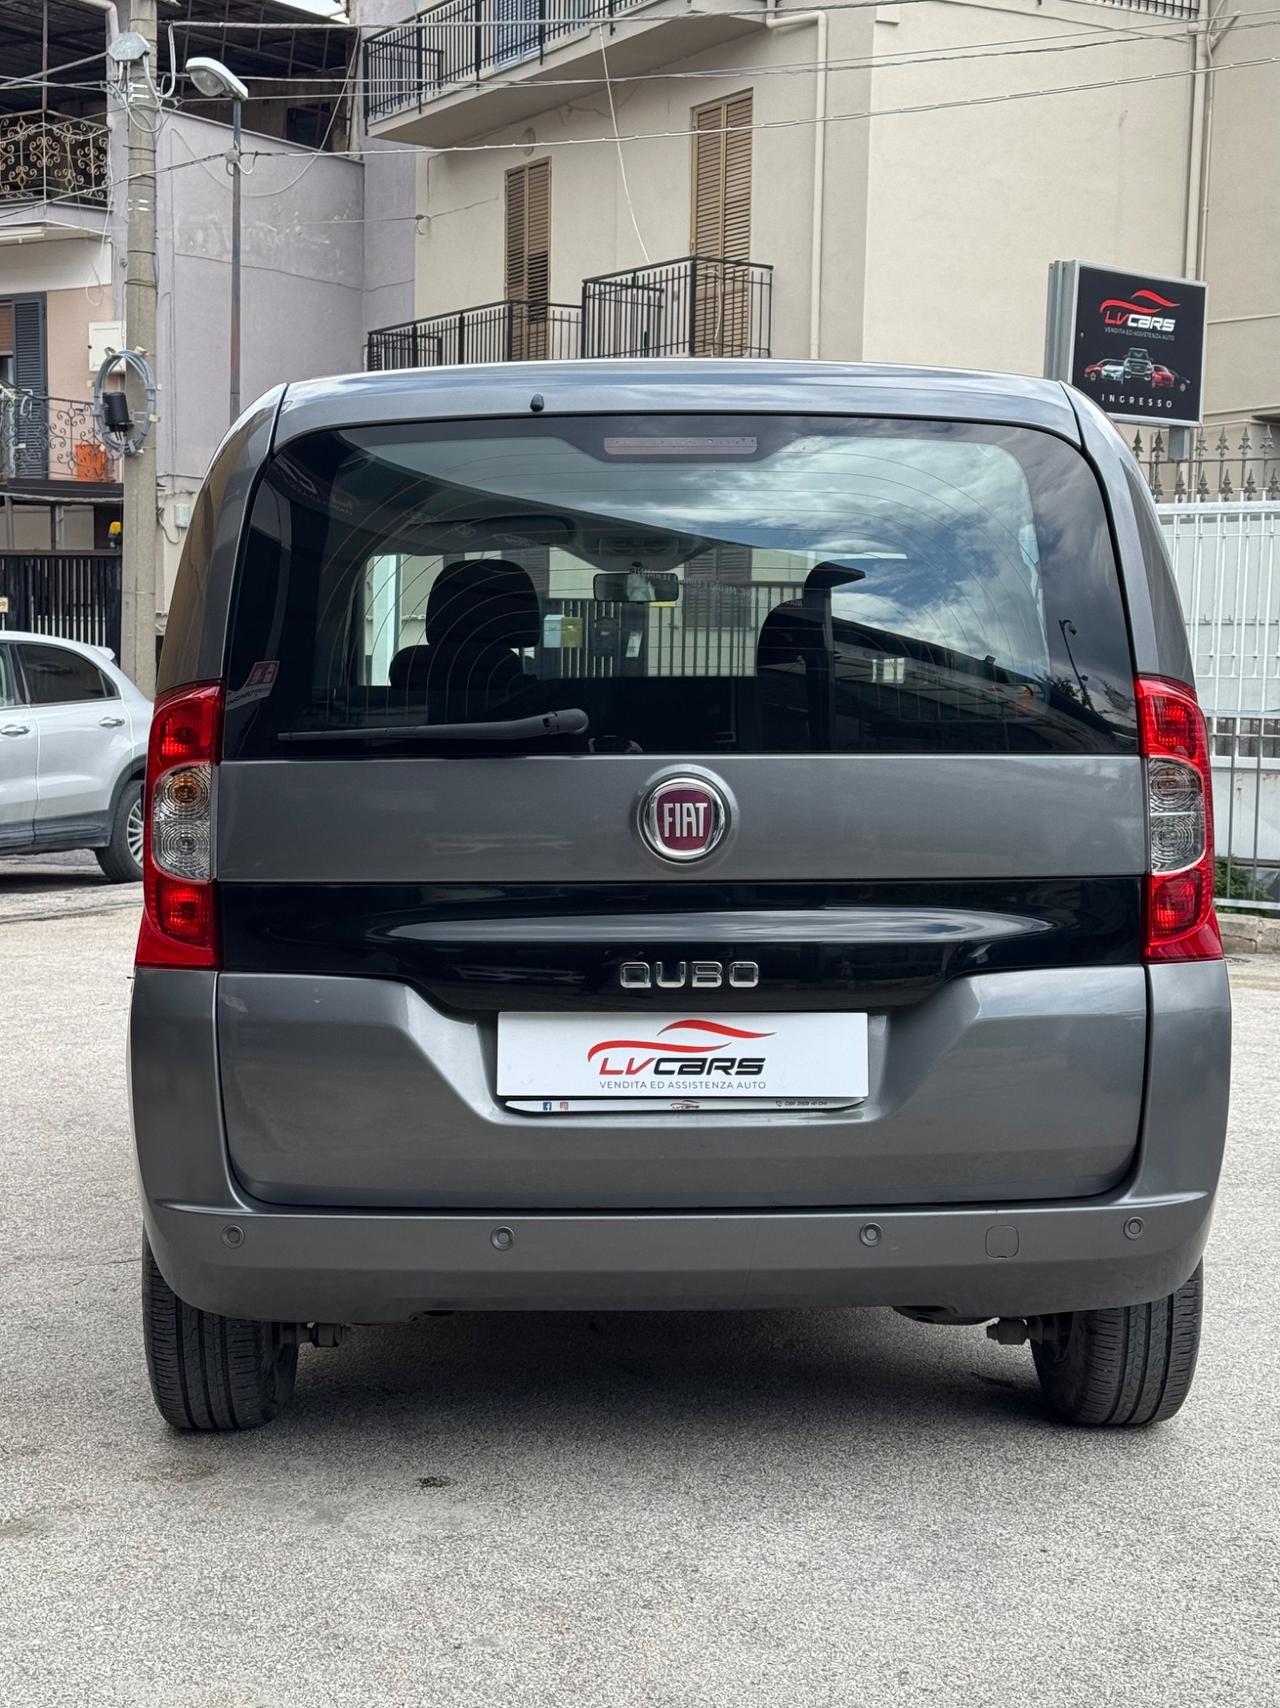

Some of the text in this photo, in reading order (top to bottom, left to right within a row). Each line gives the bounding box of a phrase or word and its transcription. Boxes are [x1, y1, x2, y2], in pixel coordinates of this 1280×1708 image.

[1101, 393, 1173, 408] INGRESSO
[663, 802, 708, 838] FIAT
[619, 961, 759, 988] QUBO
[600, 1080, 766, 1089] VENDITA ED ASSISTENZA AUTO
